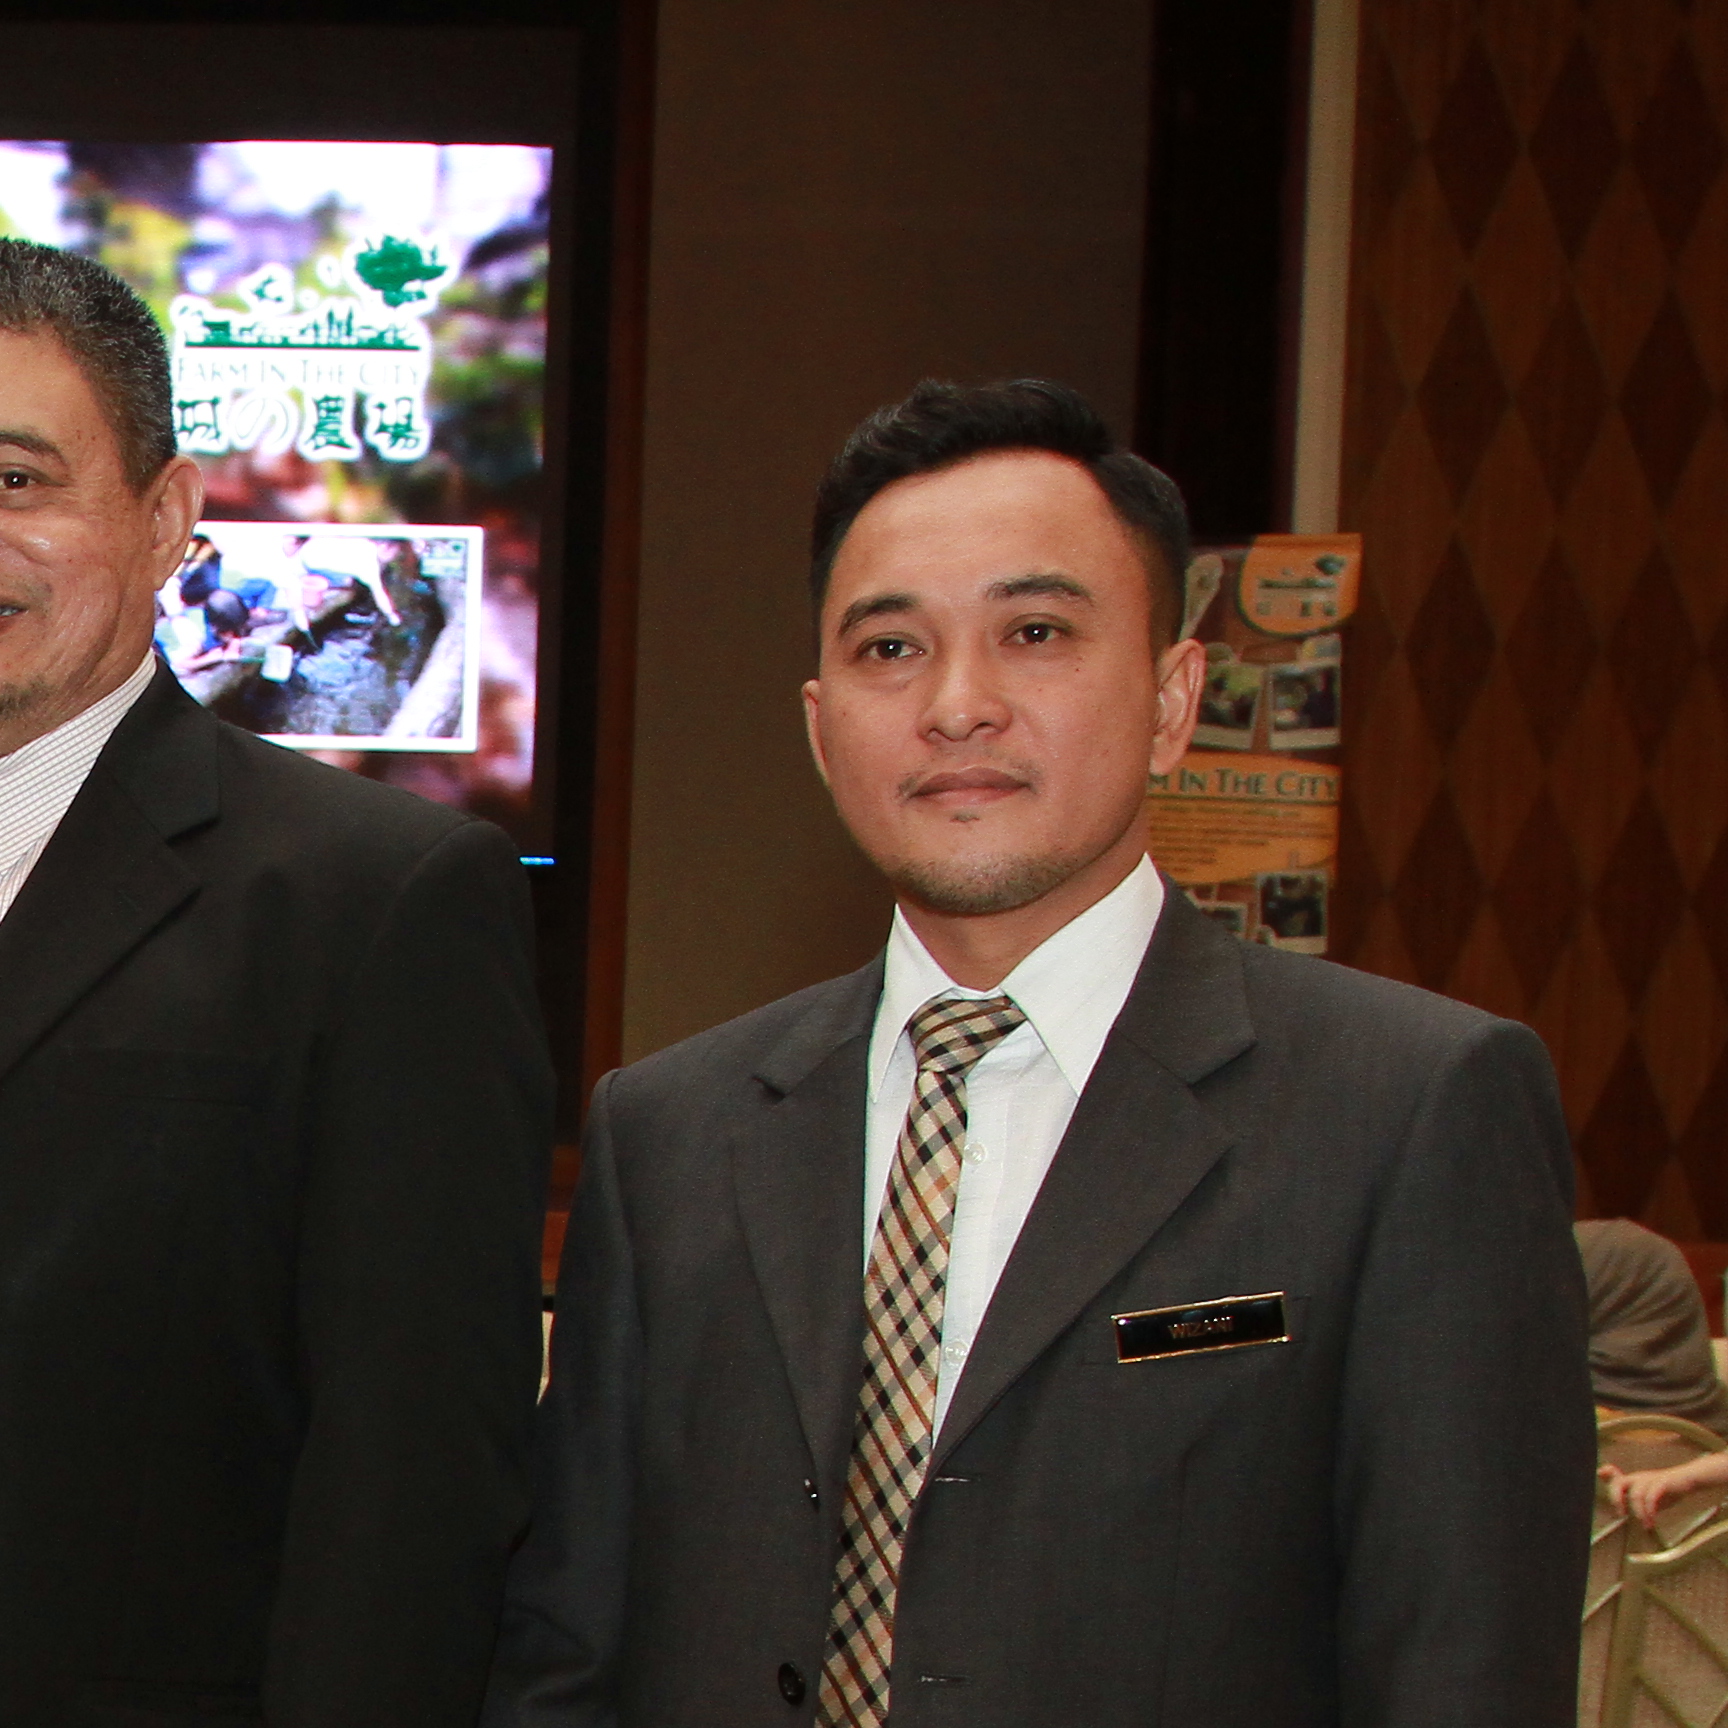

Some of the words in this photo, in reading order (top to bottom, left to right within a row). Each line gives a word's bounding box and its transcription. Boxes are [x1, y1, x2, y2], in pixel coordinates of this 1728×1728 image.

[176, 356, 249, 384] FARM
[260, 359, 287, 384] IN
[299, 358, 346, 386] THE
[358, 361, 420, 386] CITY
[1179, 767, 1208, 792] IN
[1215, 768, 1267, 795] THE
[1276, 770, 1339, 798] CITY
